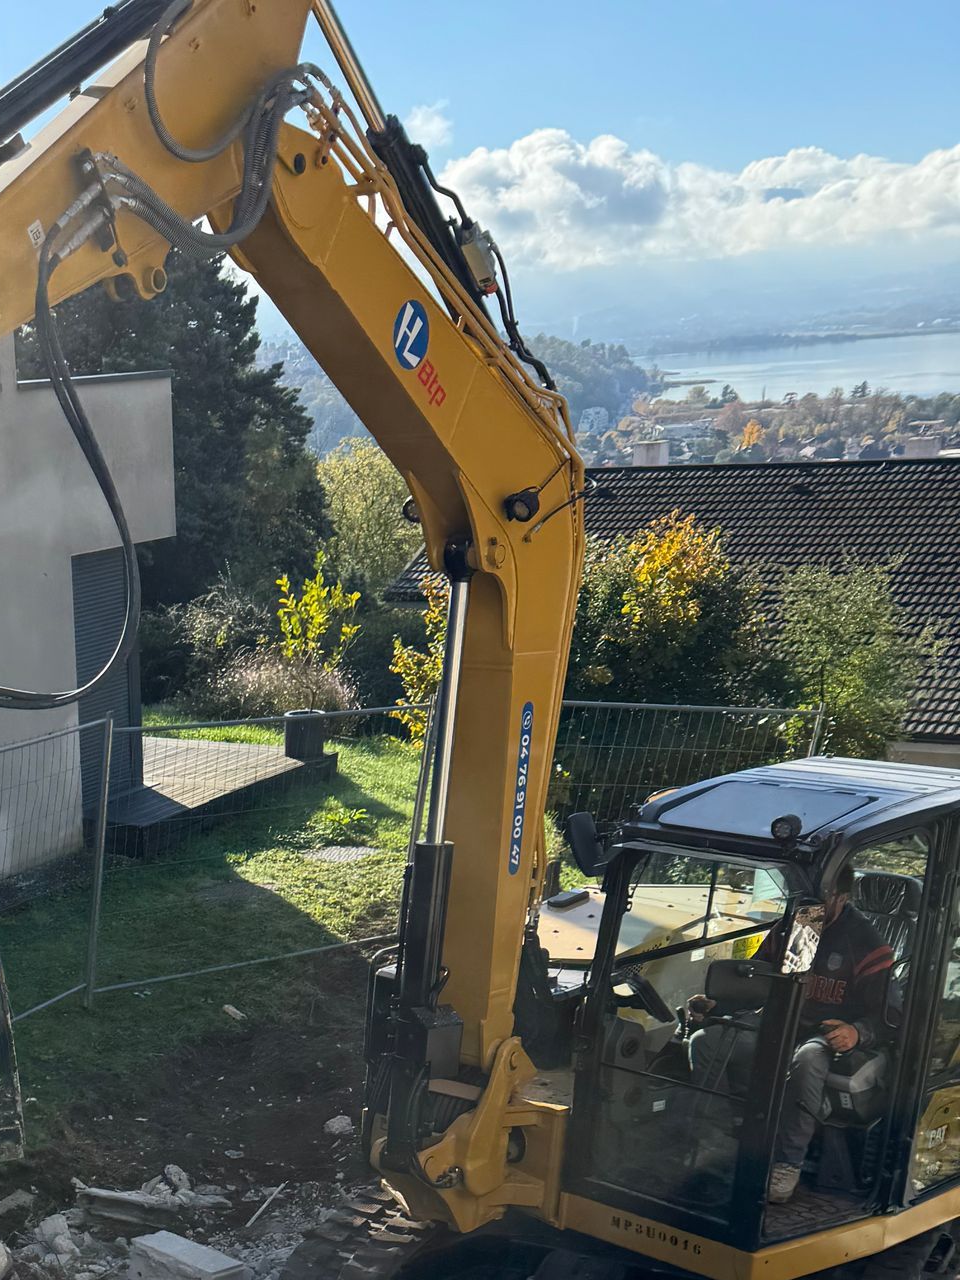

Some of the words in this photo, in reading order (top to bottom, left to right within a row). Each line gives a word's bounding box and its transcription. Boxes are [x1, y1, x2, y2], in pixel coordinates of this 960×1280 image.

[417, 360, 447, 407] Btp
[520, 735, 530, 759] 04
[517, 763, 528, 786] 76
[515, 791, 525, 810] 91
[513, 815, 523, 839] 00
[511, 844, 520, 865] 47
